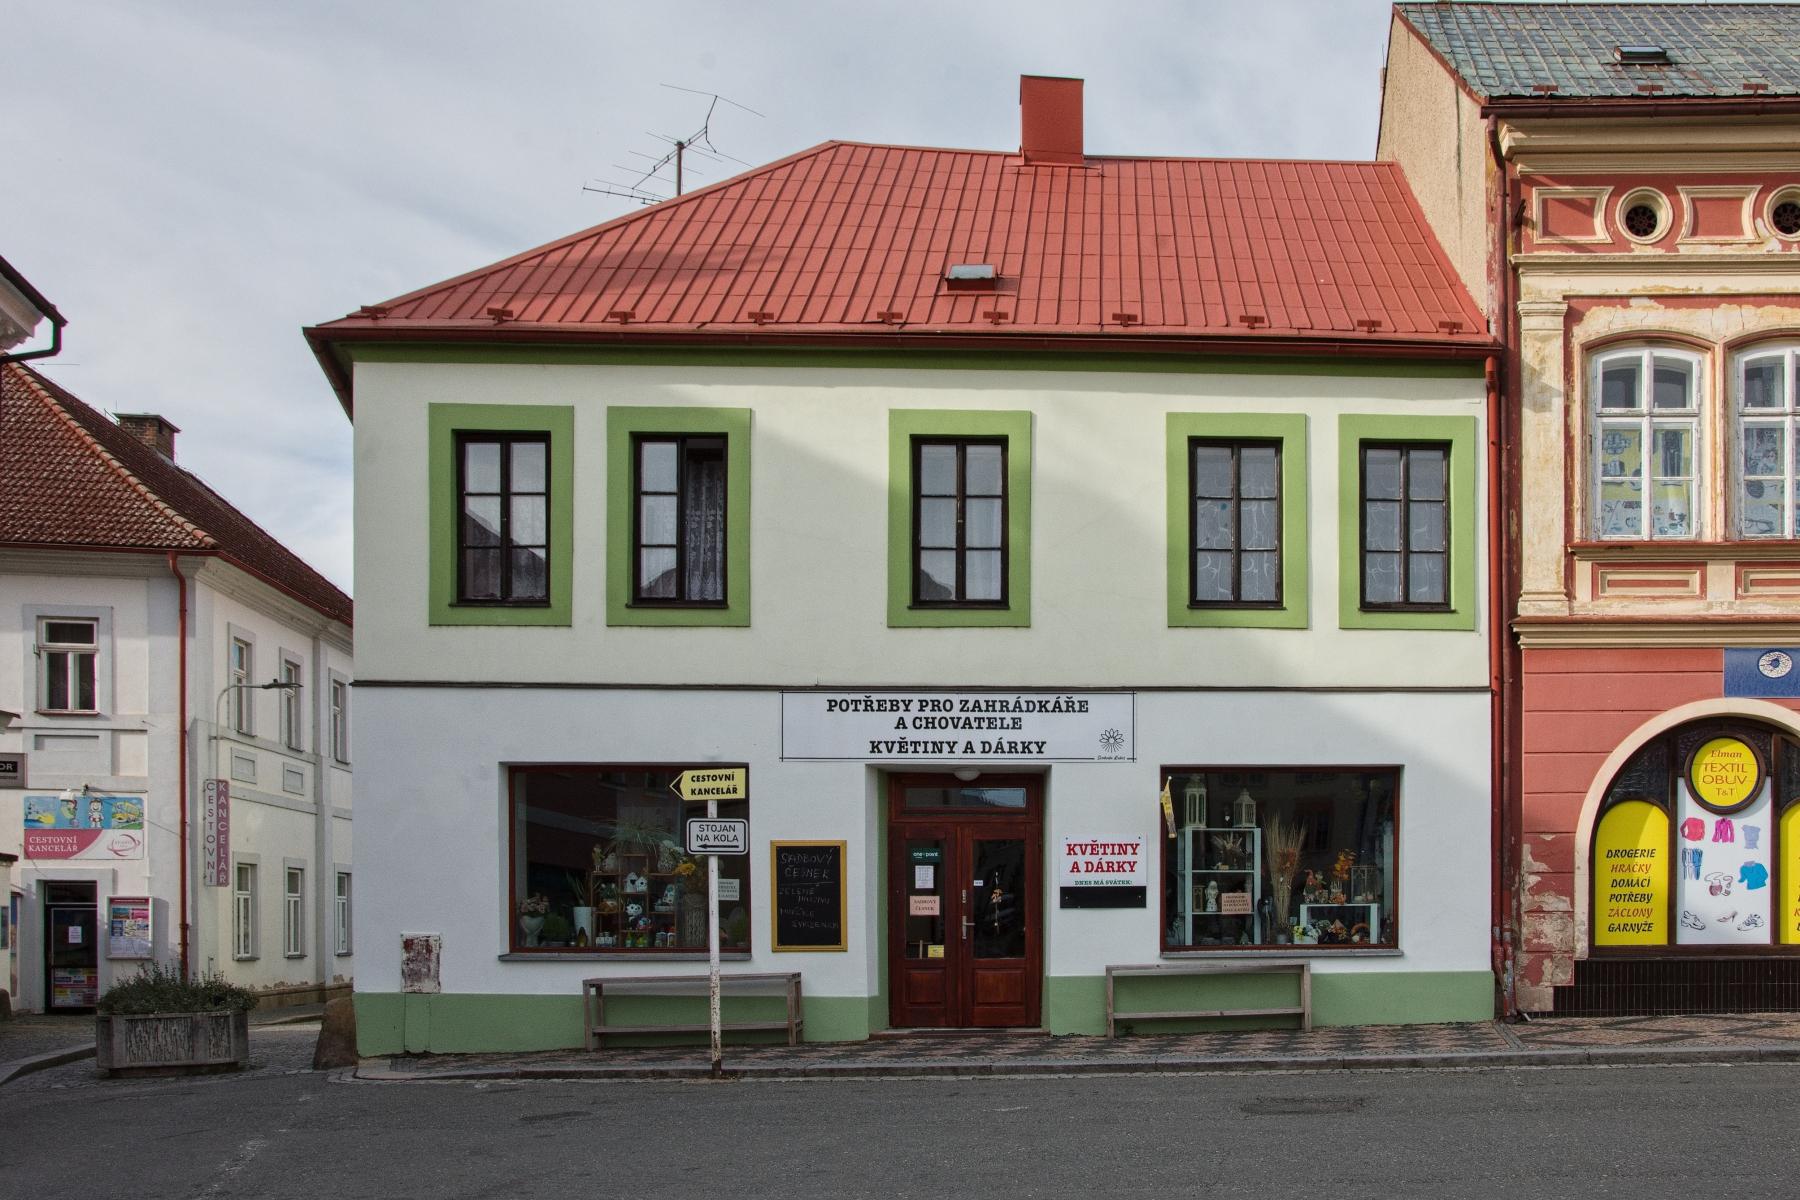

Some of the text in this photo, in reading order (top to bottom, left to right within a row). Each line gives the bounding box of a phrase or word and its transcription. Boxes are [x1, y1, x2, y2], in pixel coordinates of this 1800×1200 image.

[826, 695, 1089, 713] POTŘEBY PRO ZAHRÁDKÁŘE
[894, 716, 1022, 730] A CHOVATELE
[869, 736, 1047, 754] KVĚTINY A DÁRKY
[1711, 750, 1742, 758] Elman
[1704, 762, 1748, 773] TEXTIL
[691, 771, 735, 782] CESTOVNÍ
[1703, 775, 1747, 785] OBUV
[690, 784, 738, 796] KANCELÁŘ
[1715, 787, 1735, 797] T&T
[206, 782, 216, 884] CESTOVNÍ
[217, 782, 228, 884] KANCELÁŘ
[698, 824, 736, 833] STOJAN
[29, 835, 78, 844] CESTOVNÍ
[696, 834, 739, 843] NA KOLA
[28, 843, 78, 852] KANCELÁŘ
[1066, 839, 1140, 856] KVĚTINY
[1606, 848, 1656, 859] DROGERIE
[1070, 857, 1138, 873] A DÁRKY
[1610, 861, 1652, 874] HRAČKY
[1611, 876, 1651, 888] DOMÁCÍ
[1609, 891, 1653, 904] POTŘEBY
[1608, 905, 1653, 919] ZÁCLONY
[1608, 920, 1654, 934] GARNYŽE
